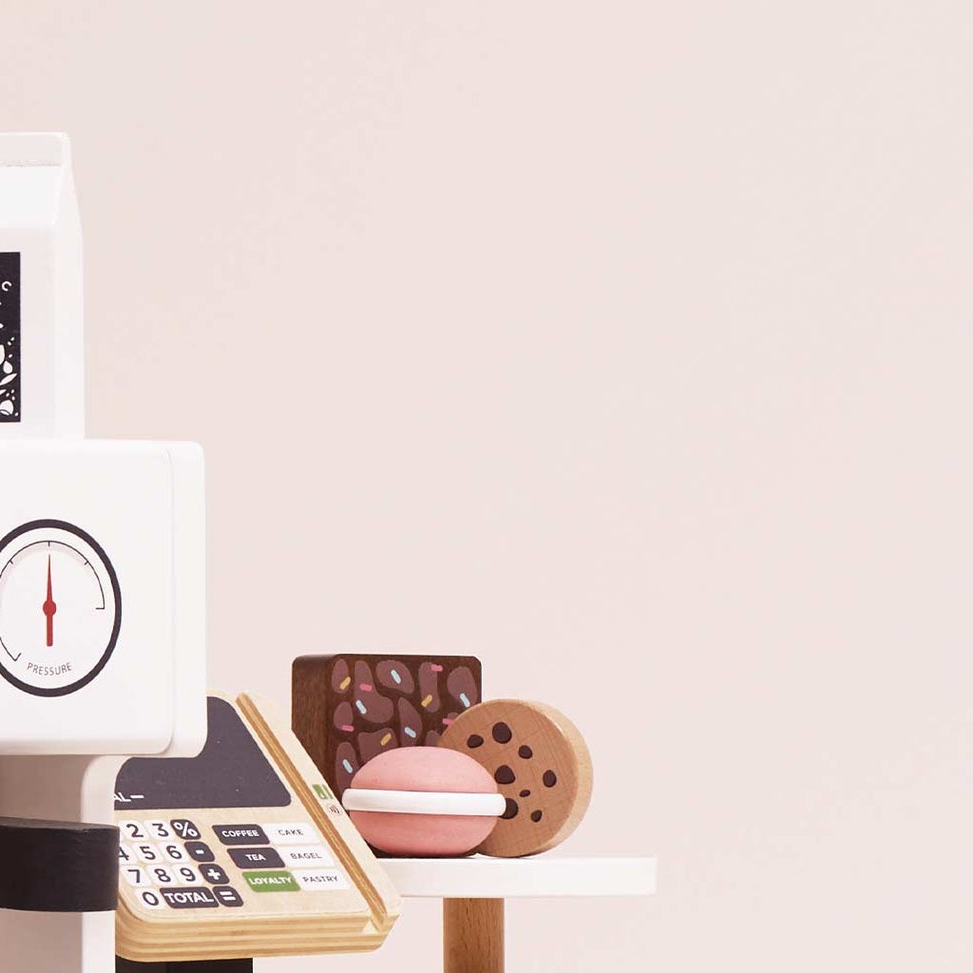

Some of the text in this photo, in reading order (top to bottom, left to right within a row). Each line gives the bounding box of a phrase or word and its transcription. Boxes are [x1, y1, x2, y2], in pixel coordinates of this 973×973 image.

[27, 661, 73, 676] PRESSURE
[126, 823, 144, 838] 2
[152, 823, 169, 837] 3
[221, 829, 260, 838] COFFEE
[277, 828, 304, 837] CAKE
[139, 846, 156, 860] 5
[166, 845, 182, 859] 6
[290, 852, 322, 860] BAGEL
[245, 853, 267, 862] TEA
[128, 869, 141, 884] 7
[154, 868, 171, 883] 8
[180, 867, 196, 882] 9
[302, 875, 338, 883] PASTRY
[248, 877, 293, 885] LOYALTY
[163, 892, 214, 904] TOTAL
